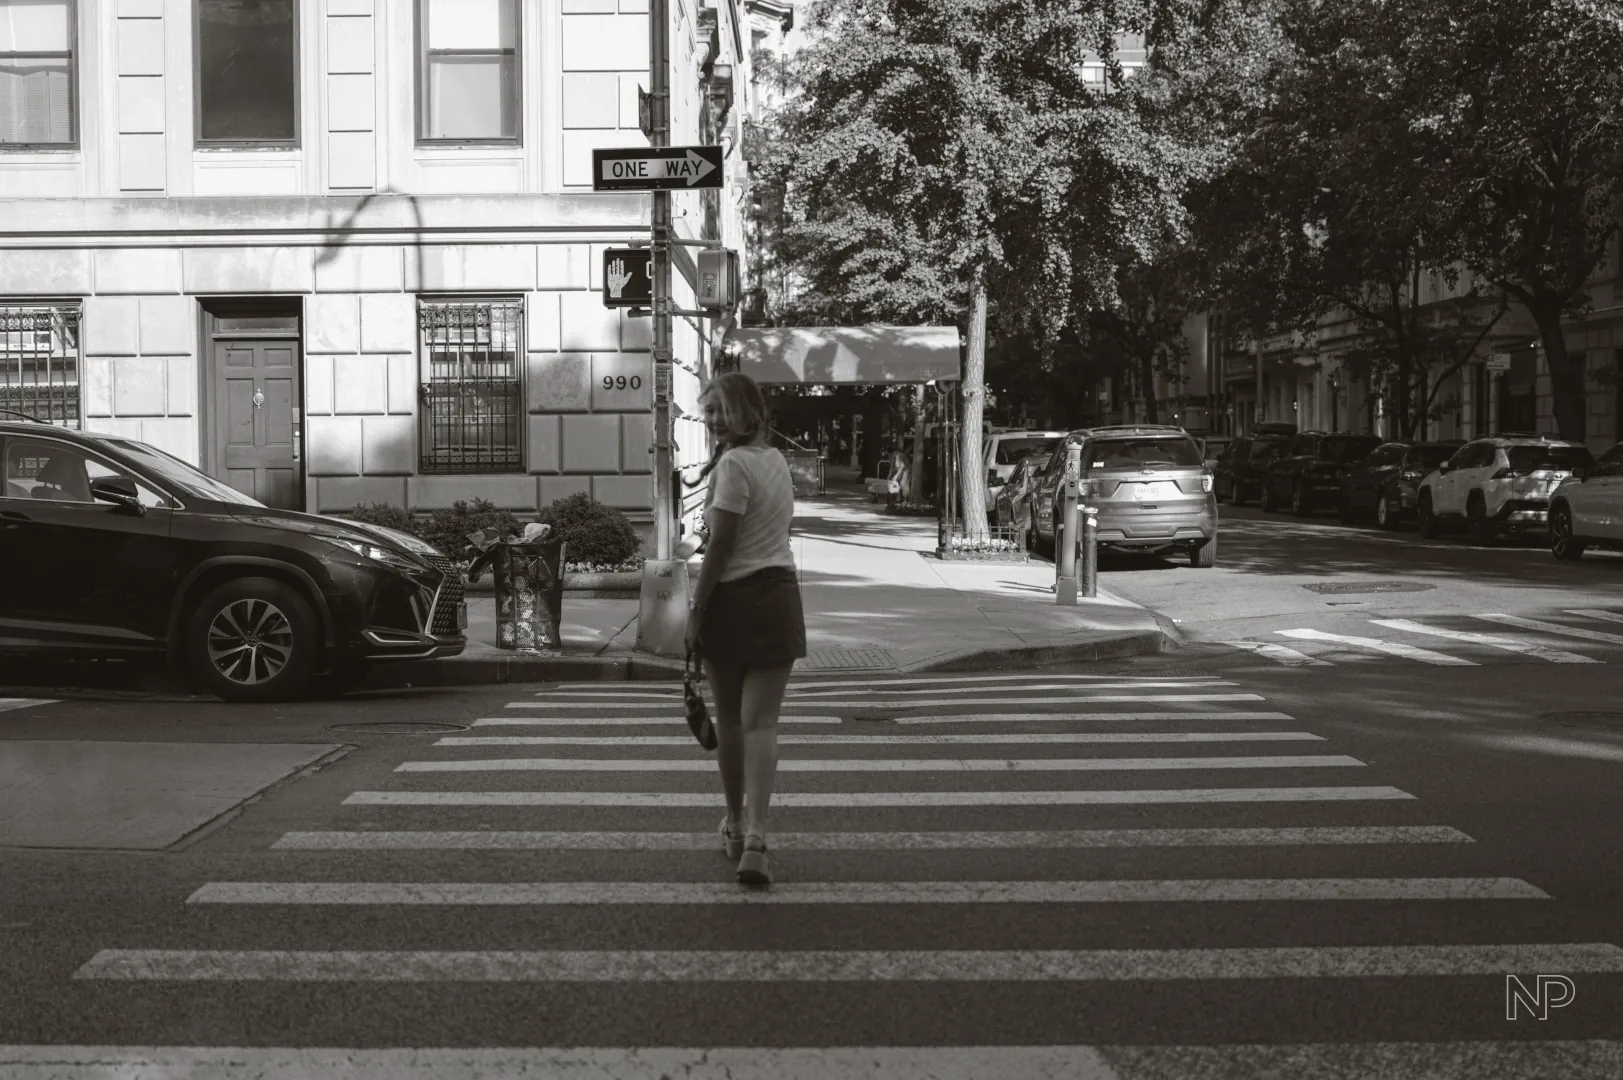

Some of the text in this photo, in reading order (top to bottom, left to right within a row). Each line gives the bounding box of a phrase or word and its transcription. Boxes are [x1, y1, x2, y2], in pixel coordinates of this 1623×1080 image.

[612, 159, 703, 178] ONE WAY
[602, 375, 642, 390] 990
